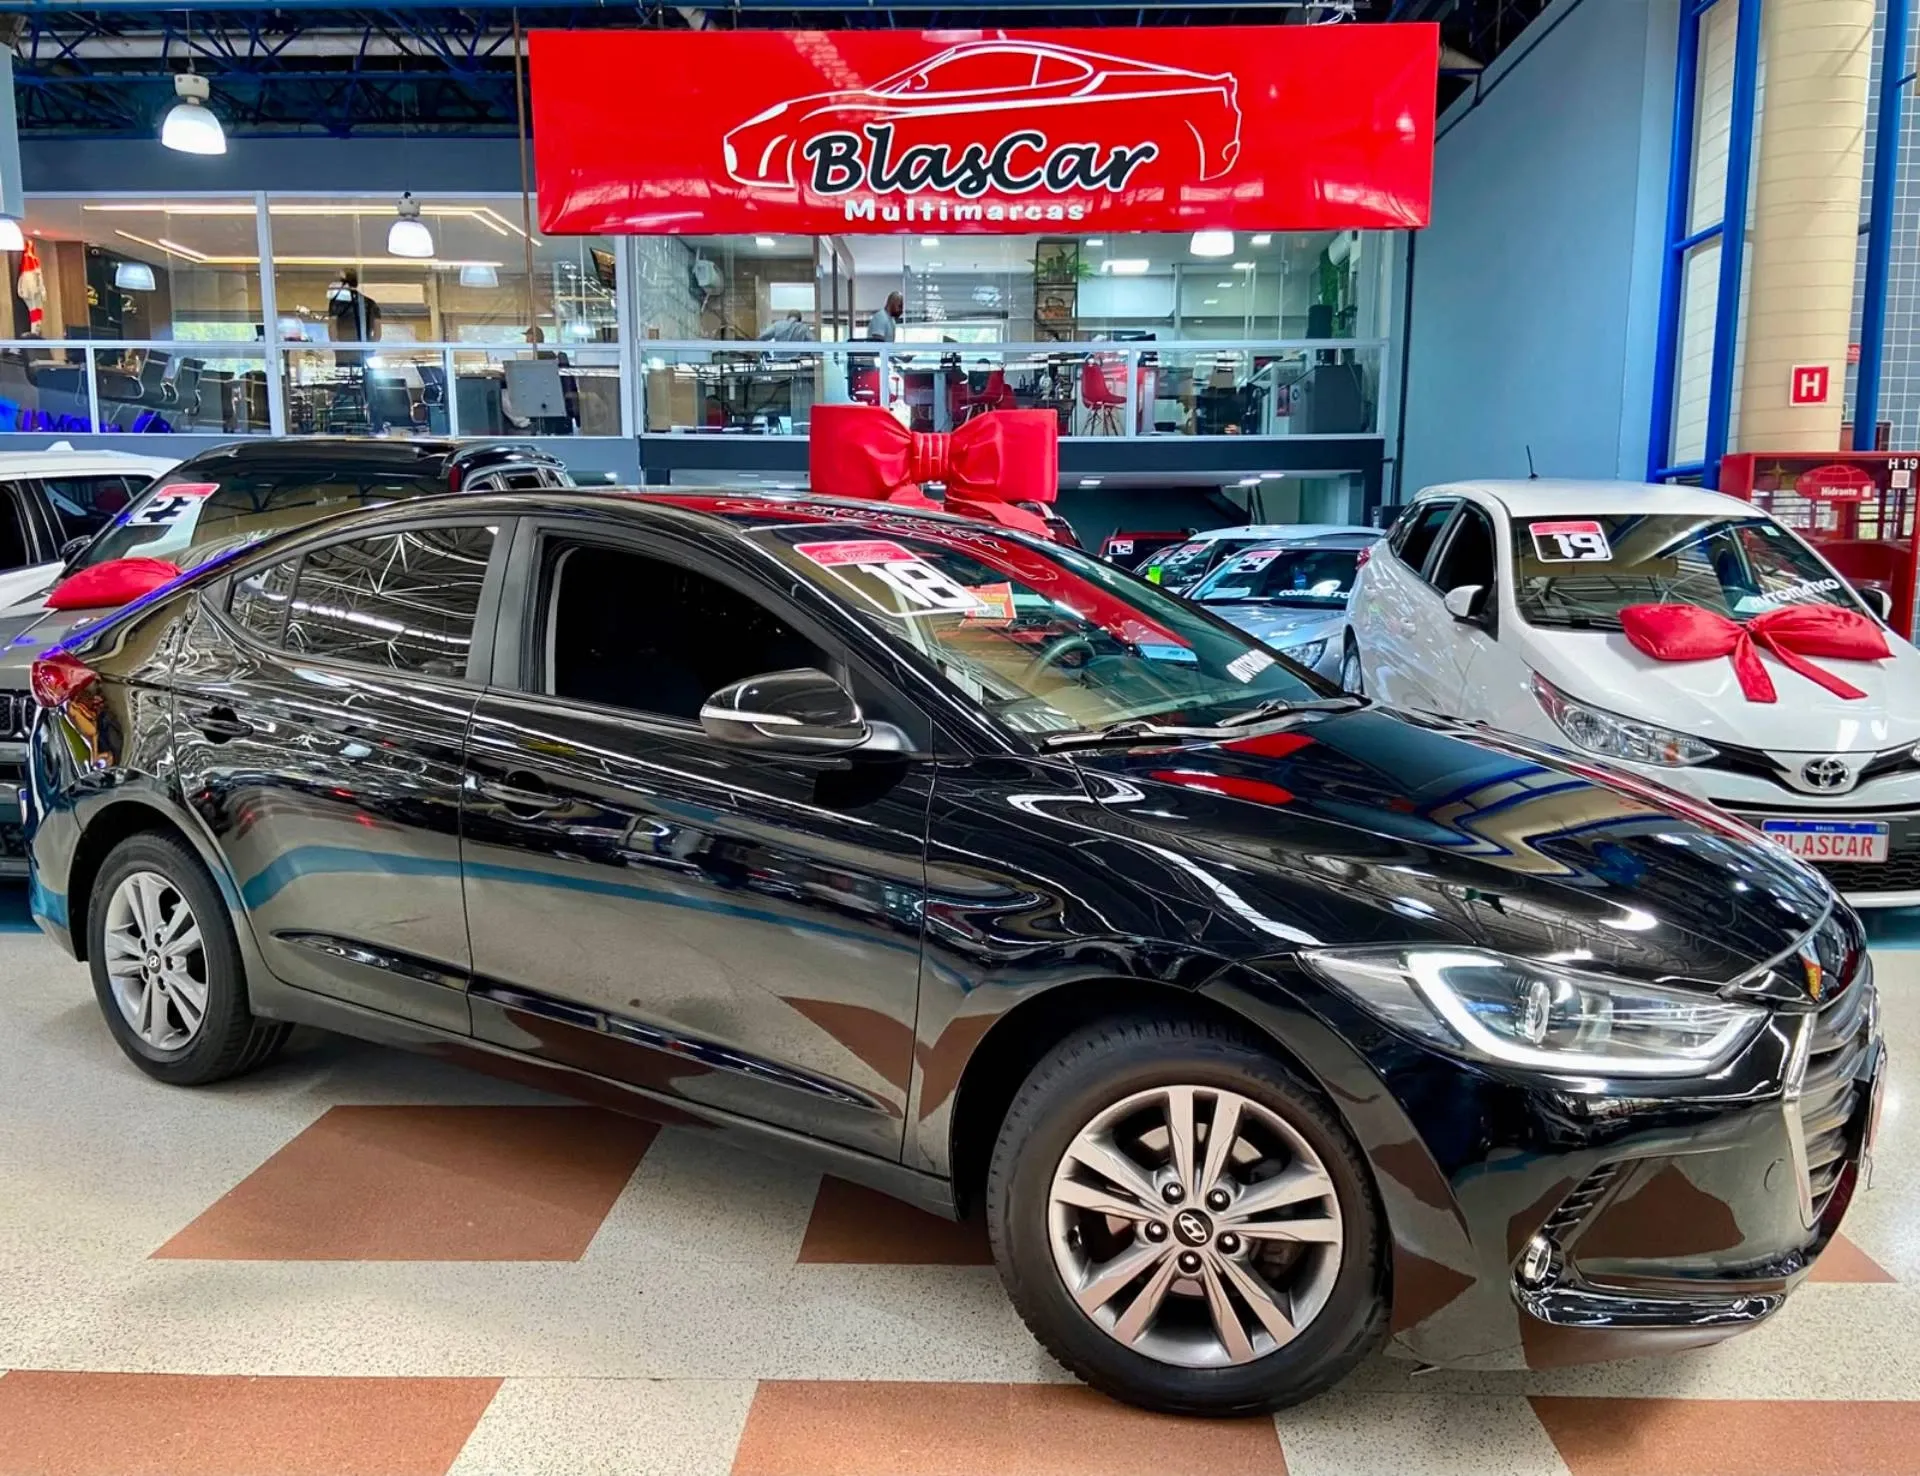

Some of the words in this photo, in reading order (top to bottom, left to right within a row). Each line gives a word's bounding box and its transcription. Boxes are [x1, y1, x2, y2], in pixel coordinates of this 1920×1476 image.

[803, 122, 1159, 198] BlasCar
[844, 200, 1085, 221] Multimarcas
[1801, 372, 1820, 398] H
[1888, 457, 1898, 470] H
[1903, 457, 1918, 470] 19
[1821, 486, 1857, 497] Hidrante
[1552, 534, 1607, 559] 19
[857, 563, 979, 607] 18
